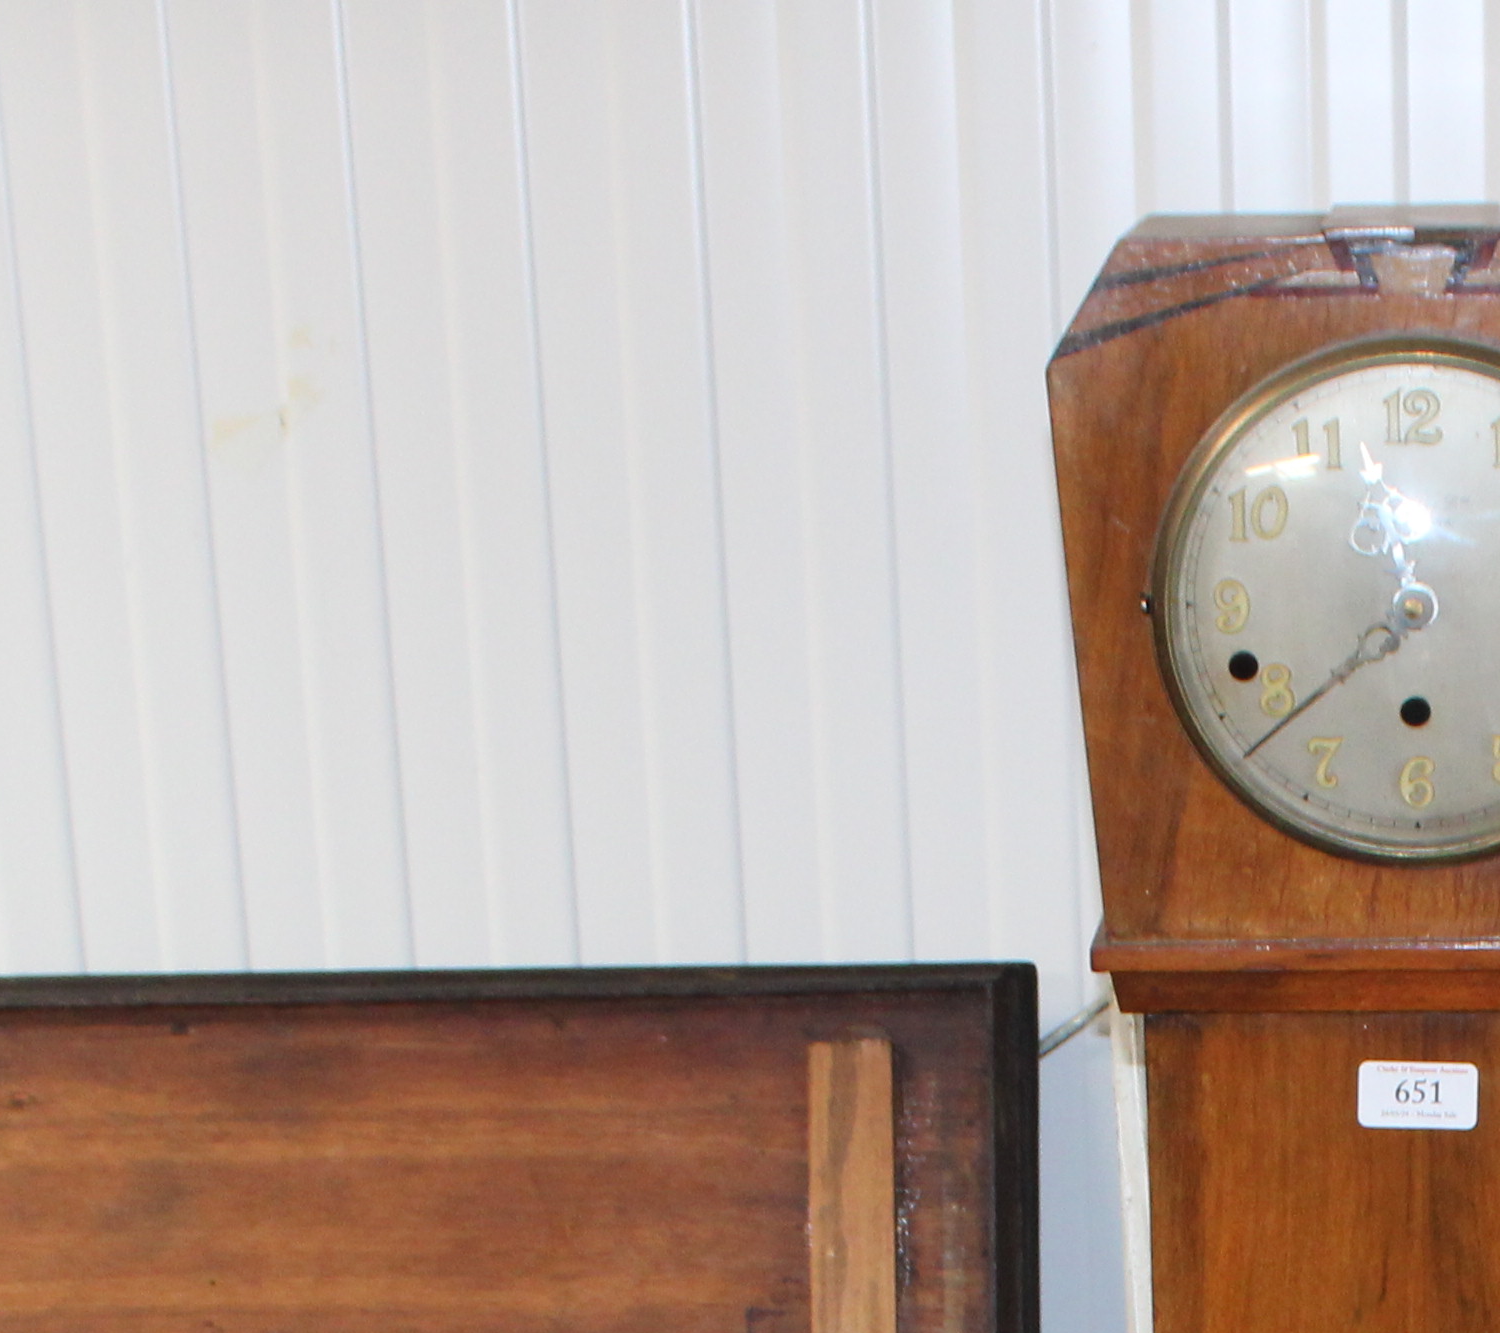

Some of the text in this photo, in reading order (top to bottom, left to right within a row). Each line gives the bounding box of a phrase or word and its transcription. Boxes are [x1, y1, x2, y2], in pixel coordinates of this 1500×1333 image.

[1383, 387, 1442, 446] 12
[1292, 417, 1342, 470] 11
[1228, 485, 1289, 542] 10
[1213, 578, 1251, 634] 9
[1259, 663, 1295, 716] 8
[1307, 737, 1344, 789] 7
[1400, 756, 1436, 808] 6
[1395, 1079, 1442, 1105] 651
